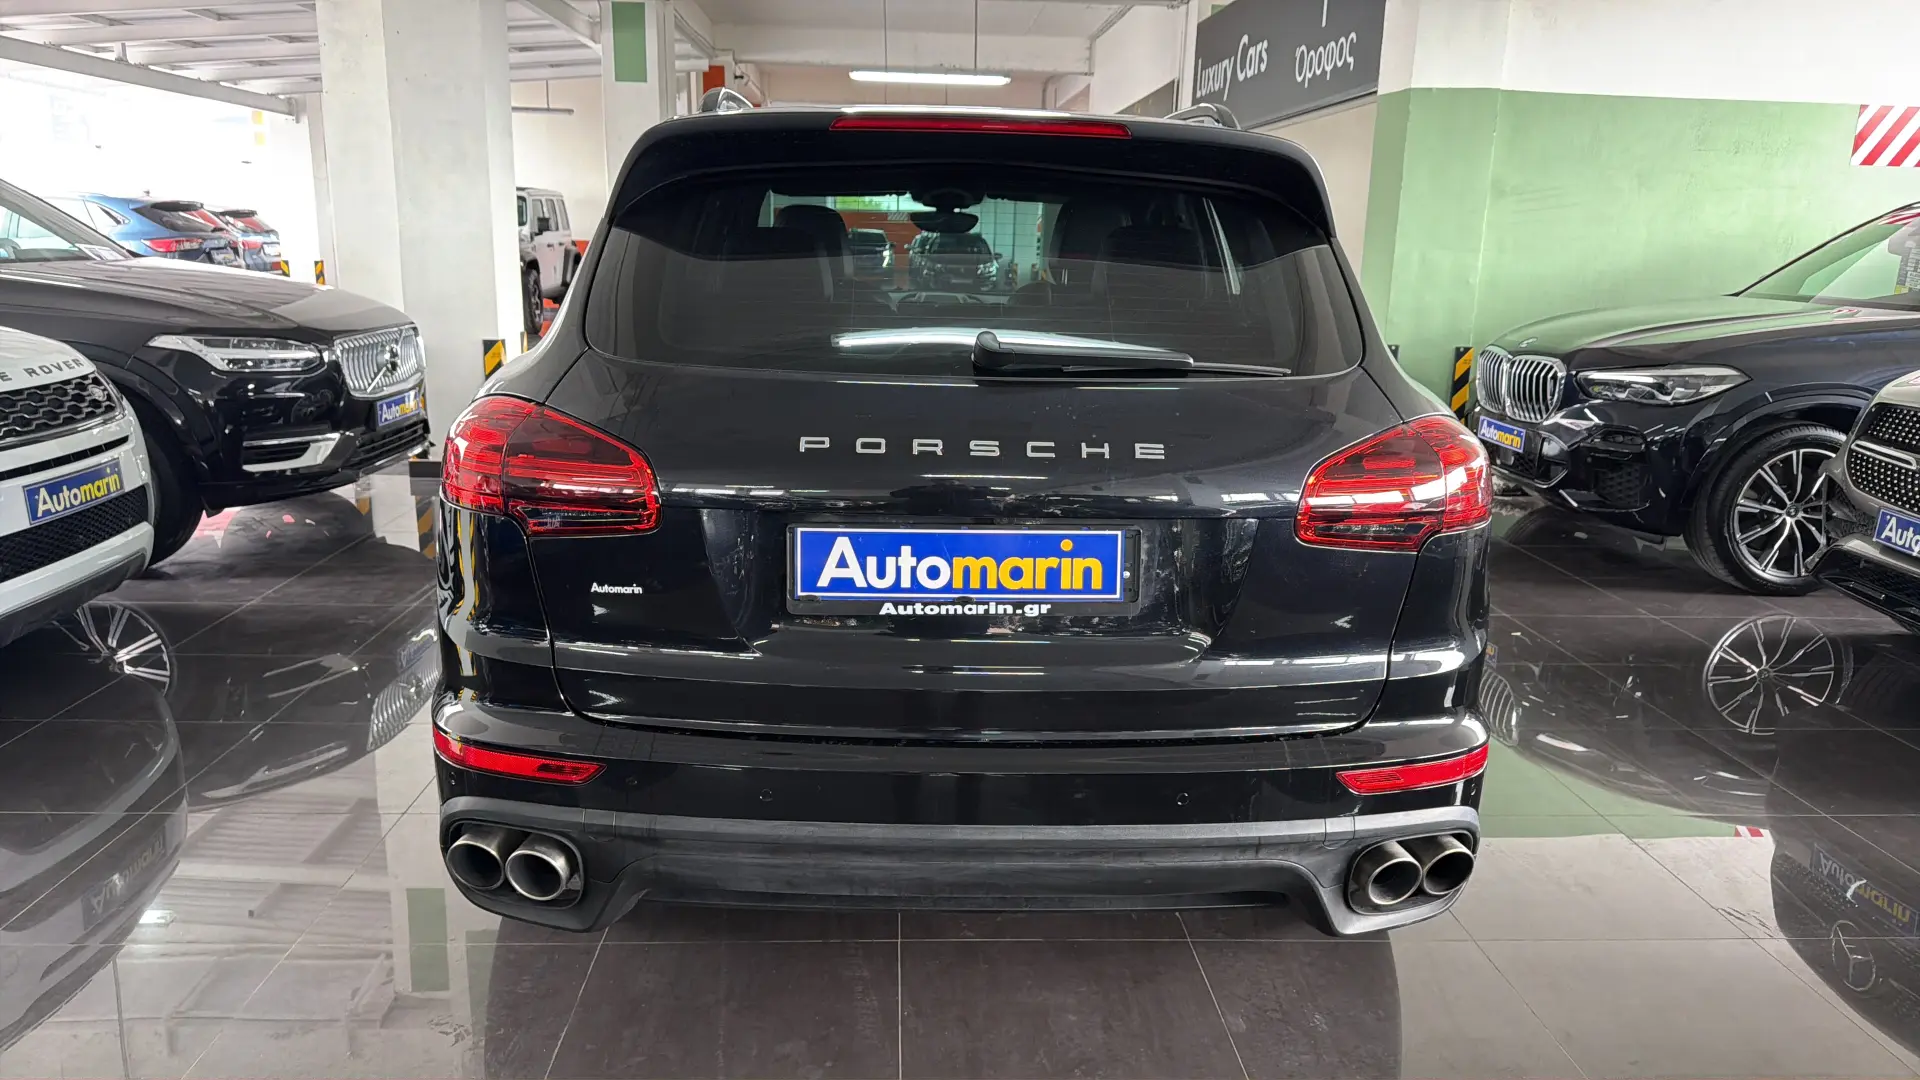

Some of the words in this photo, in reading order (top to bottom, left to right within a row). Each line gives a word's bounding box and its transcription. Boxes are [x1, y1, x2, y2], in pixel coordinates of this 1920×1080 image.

[1195, 55, 1235, 101] Luxury
[1236, 33, 1269, 82] Cars
[1295, 31, 1357, 88] Όροφος
[23, 358, 84, 378] ROVER
[799, 436, 1165, 460] PORSCHE
[1480, 420, 1521, 449] Automarin
[36, 471, 121, 518] Automarin
[816, 537, 1103, 591] Automarin
[590, 582, 643, 595] Automarin
[878, 601, 1052, 618] Automarin.gr
